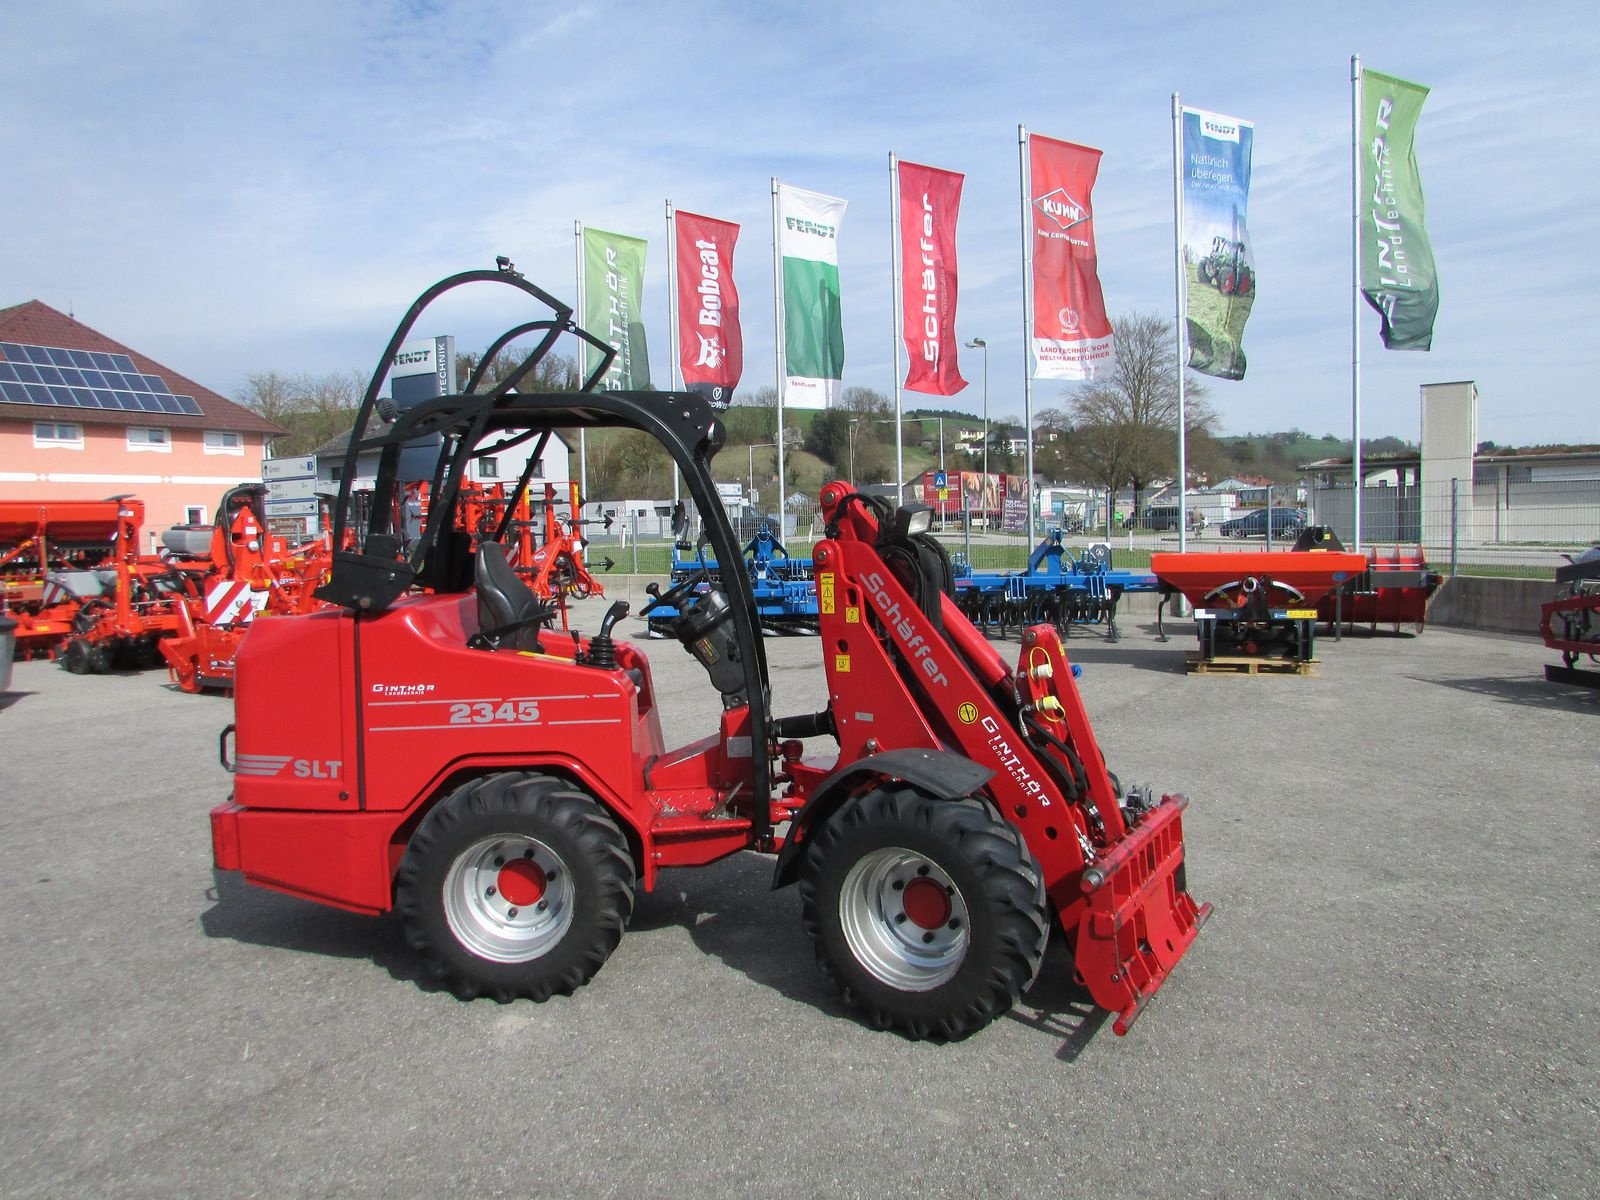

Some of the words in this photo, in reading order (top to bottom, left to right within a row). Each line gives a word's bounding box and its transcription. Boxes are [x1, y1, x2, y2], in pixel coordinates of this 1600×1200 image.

[1043, 199, 1079, 221] KUHN
[786, 217, 835, 239] FENDT
[695, 239, 721, 328] Bobcat
[920, 193, 940, 373] Schäffer
[394, 350, 431, 367] FENDT
[1040, 346, 1089, 354] LANDTECHNIK
[1091, 343, 1109, 352] VOM
[859, 572, 949, 688] Schäffer
[372, 683, 435, 693] GINTHÖR
[449, 702, 540, 725] 2345
[294, 759, 343, 779] SLT
[980, 716, 1051, 808] GINTHÖR
